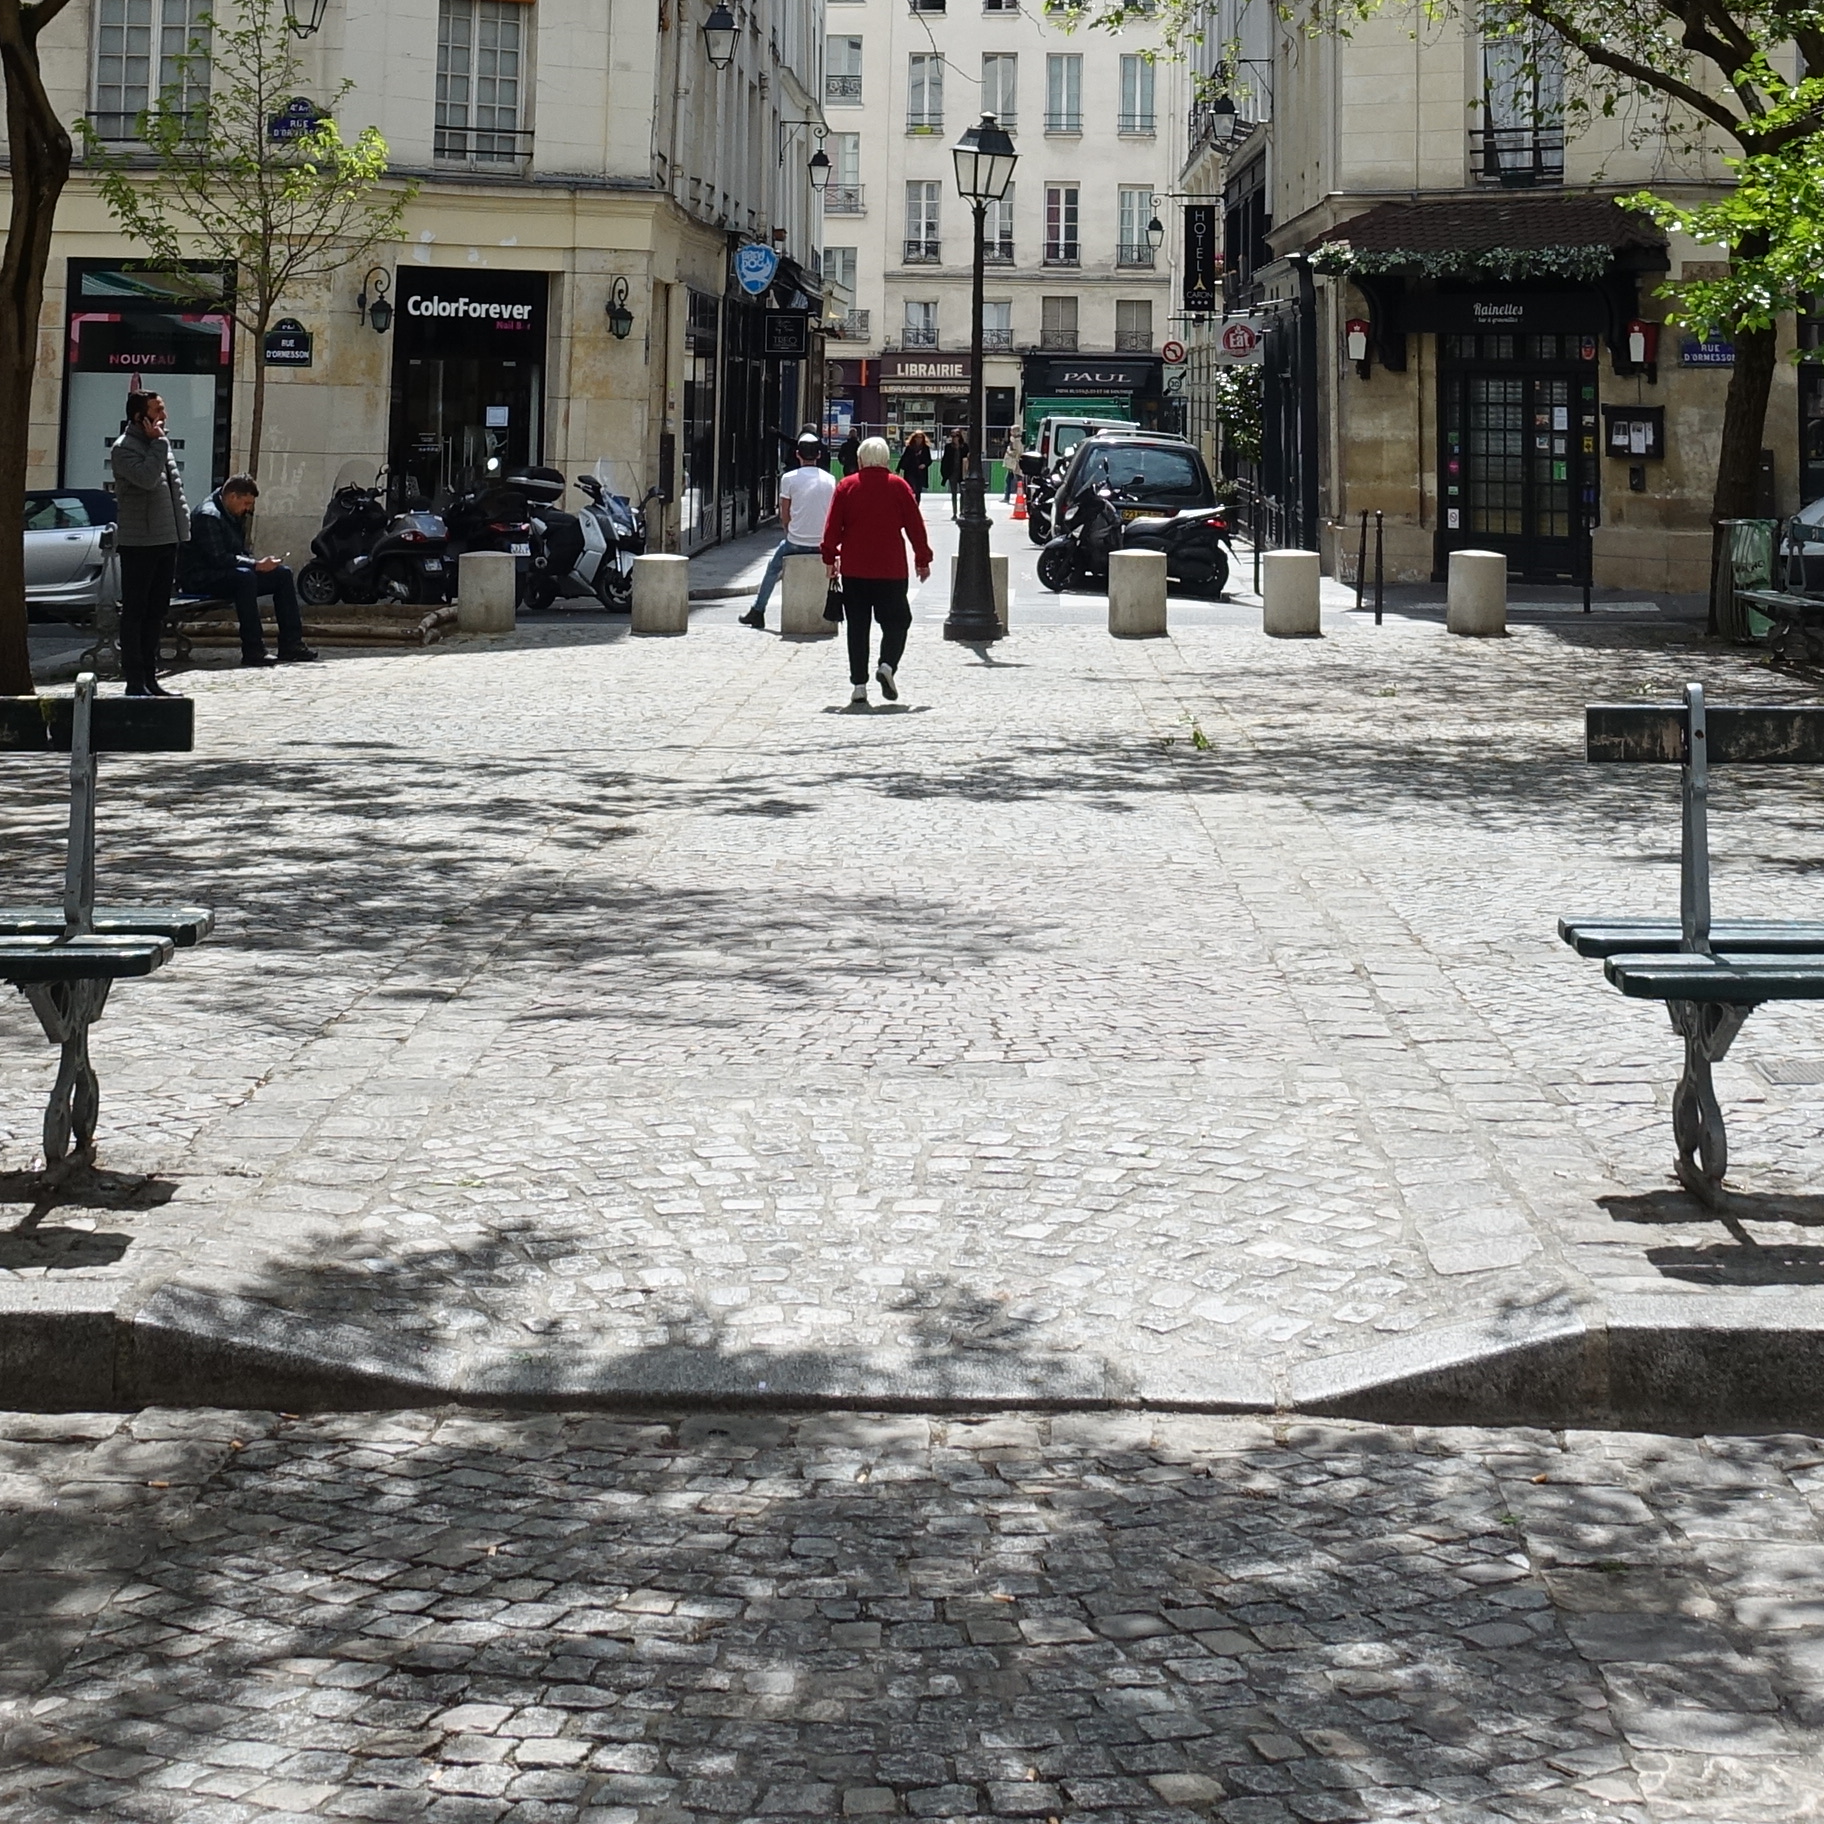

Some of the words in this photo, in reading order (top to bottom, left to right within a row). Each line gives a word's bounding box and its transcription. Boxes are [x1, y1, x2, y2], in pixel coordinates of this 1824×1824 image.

[289, 119, 309, 128] RUE
[1193, 210, 1207, 272] HOTEL
[407, 295, 533, 320] ColorForever
[1229, 332, 1251, 348] Eat
[1701, 344, 1721, 352] RUE
[109, 354, 176, 365] NOUVEAU
[897, 363, 964, 376] LIBRAIRIE
[1063, 372, 1133, 383] PAUL
[884, 385, 922, 393] LIBRAIRIE
[925, 385, 937, 393] DU
[939, 385, 971, 394] MARAIS
